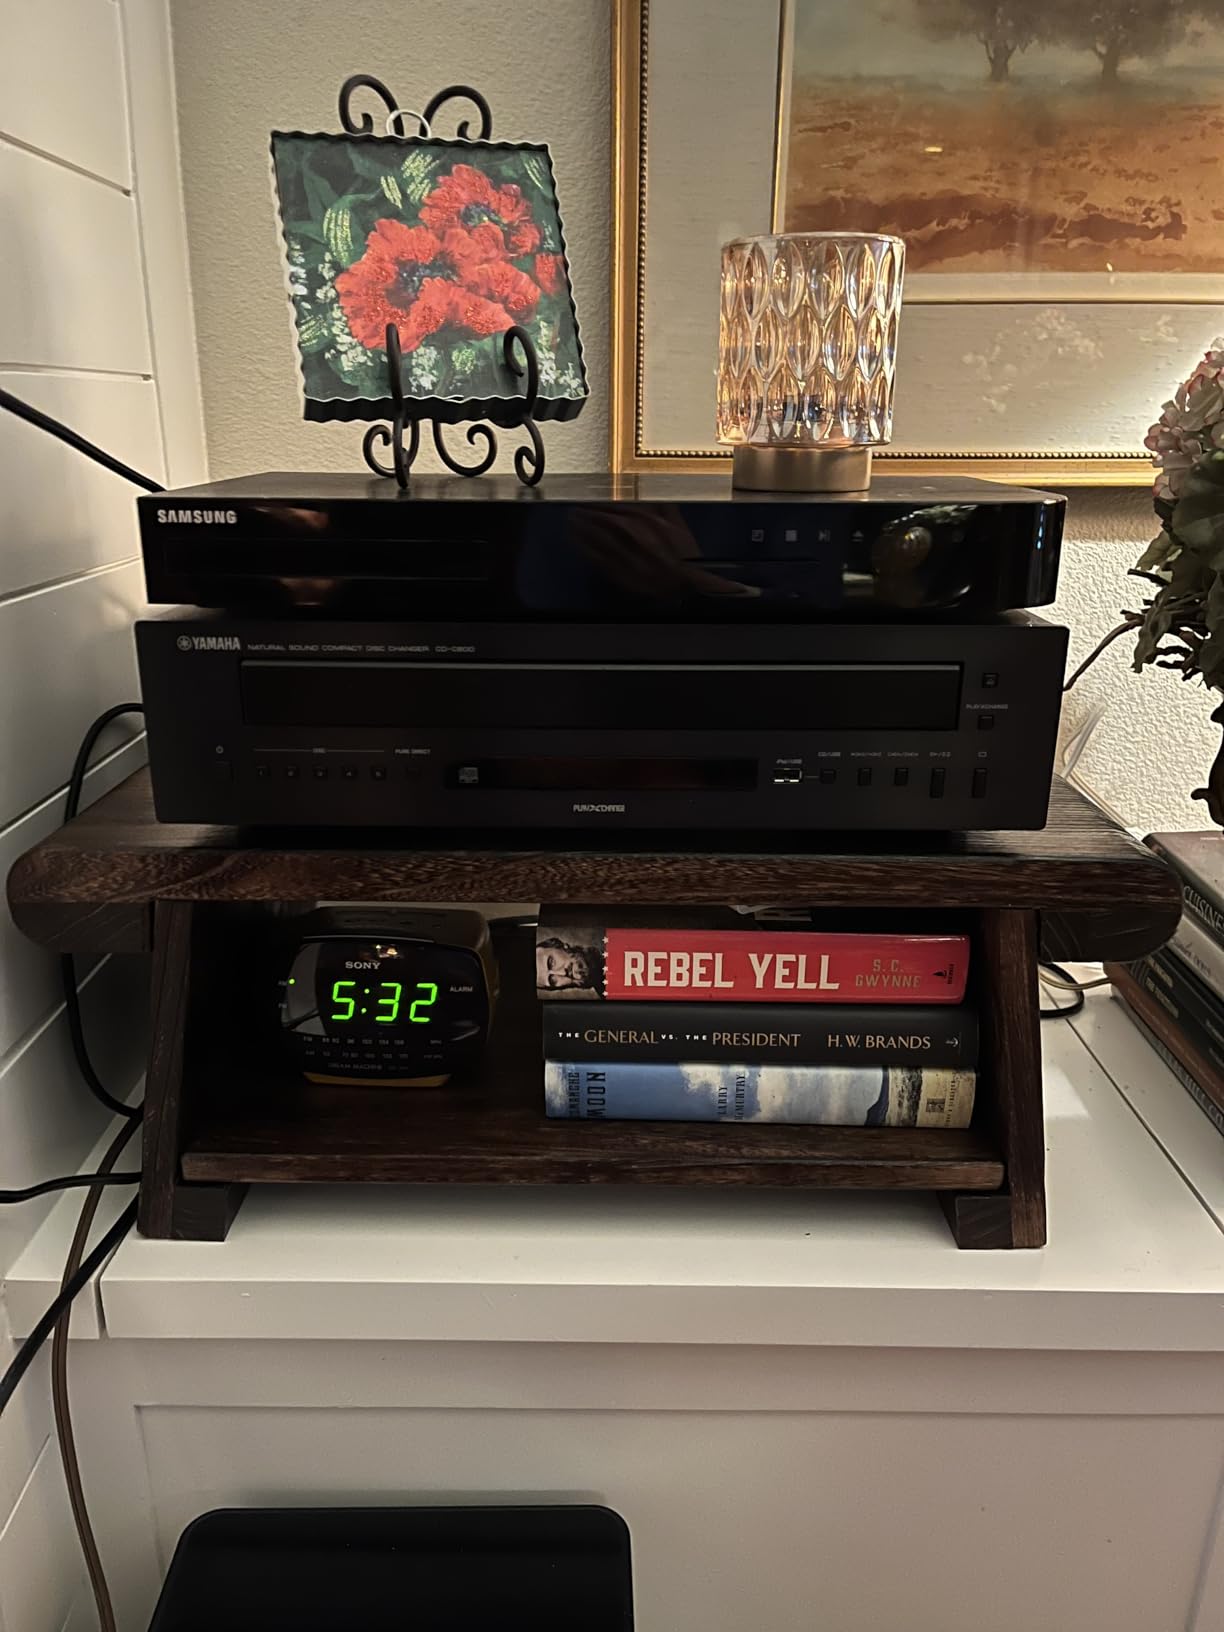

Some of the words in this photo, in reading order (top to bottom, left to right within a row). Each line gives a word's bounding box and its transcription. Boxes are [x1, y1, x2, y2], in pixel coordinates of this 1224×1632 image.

[157, 509, 237, 524] SAMSUNG
[191, 636, 241, 651] YAMAHA
[247, 643, 286, 652] NATURAL
[288, 643, 319, 652] SOUND
[321, 644, 363, 653] COMPACT
[366, 644, 386, 653] DISC
[388, 645, 430, 654] CHANGER
[345, 961, 381, 970] SONY
[624, 951, 734, 988] REBEL
[748, 953, 840, 989] YELL
[873, 959, 886, 972] S.
[855, 975, 922, 987] GWYNNE
[449, 985, 473, 993] ALARM
[331, 980, 438, 1023] 5:32
[558, 1031, 580, 1039] THE
[584, 1029, 659, 1044] GENERAL
[712, 1032, 801, 1047] PRESIDENT
[865, 1035, 931, 1050] BRANDS
[586, 1071, 606, 1118] MOON
[717, 1086, 728, 1115] LARRY
